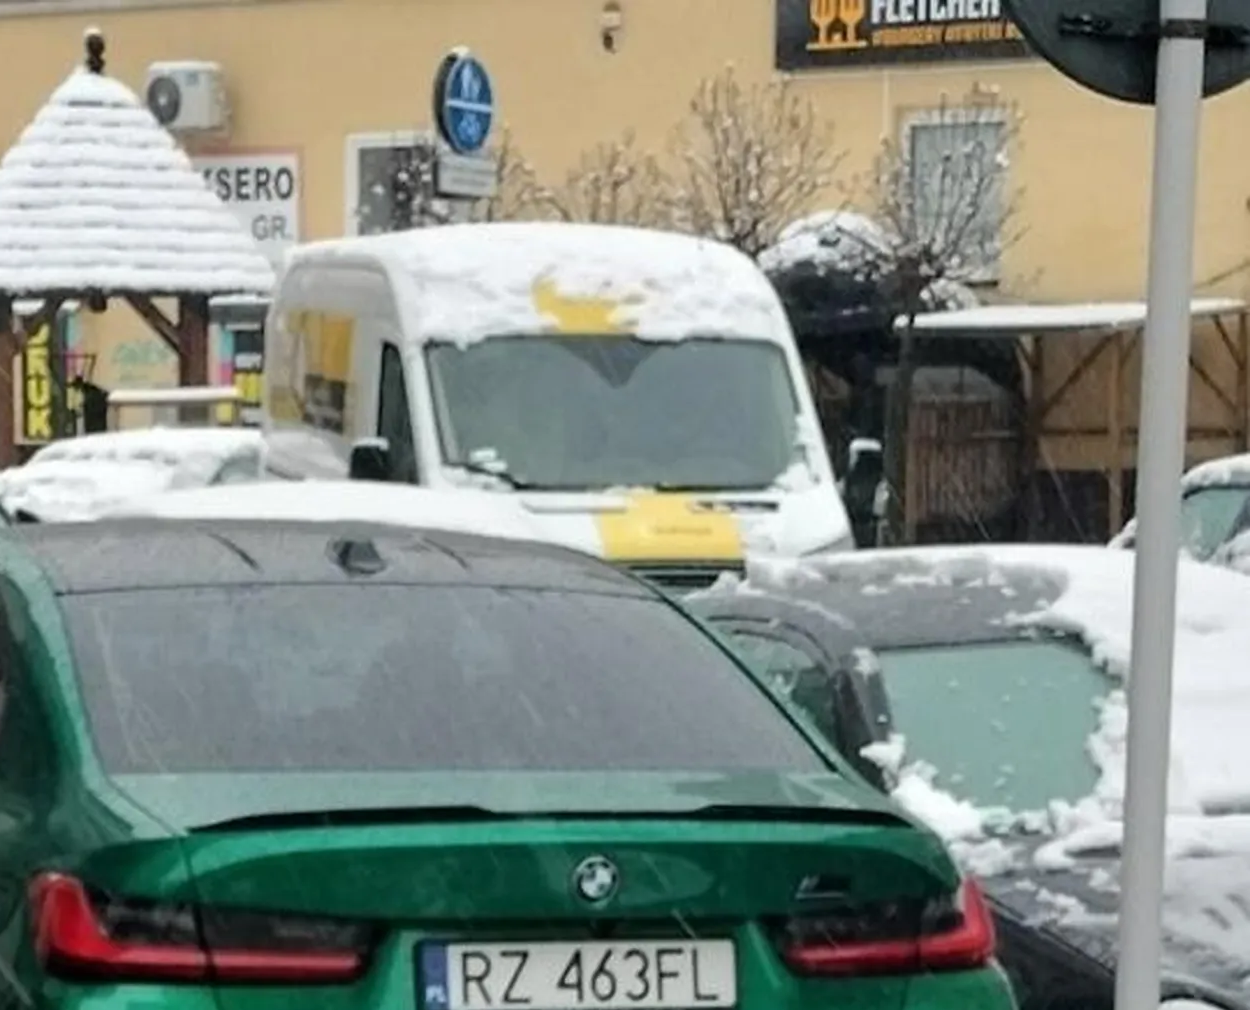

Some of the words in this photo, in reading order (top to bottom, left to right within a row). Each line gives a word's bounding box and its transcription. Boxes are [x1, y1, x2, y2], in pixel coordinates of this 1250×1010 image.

[203, 166, 294, 202] SERO
[461, 951, 532, 1005] RZ
[556, 946, 719, 1004] 463FL
